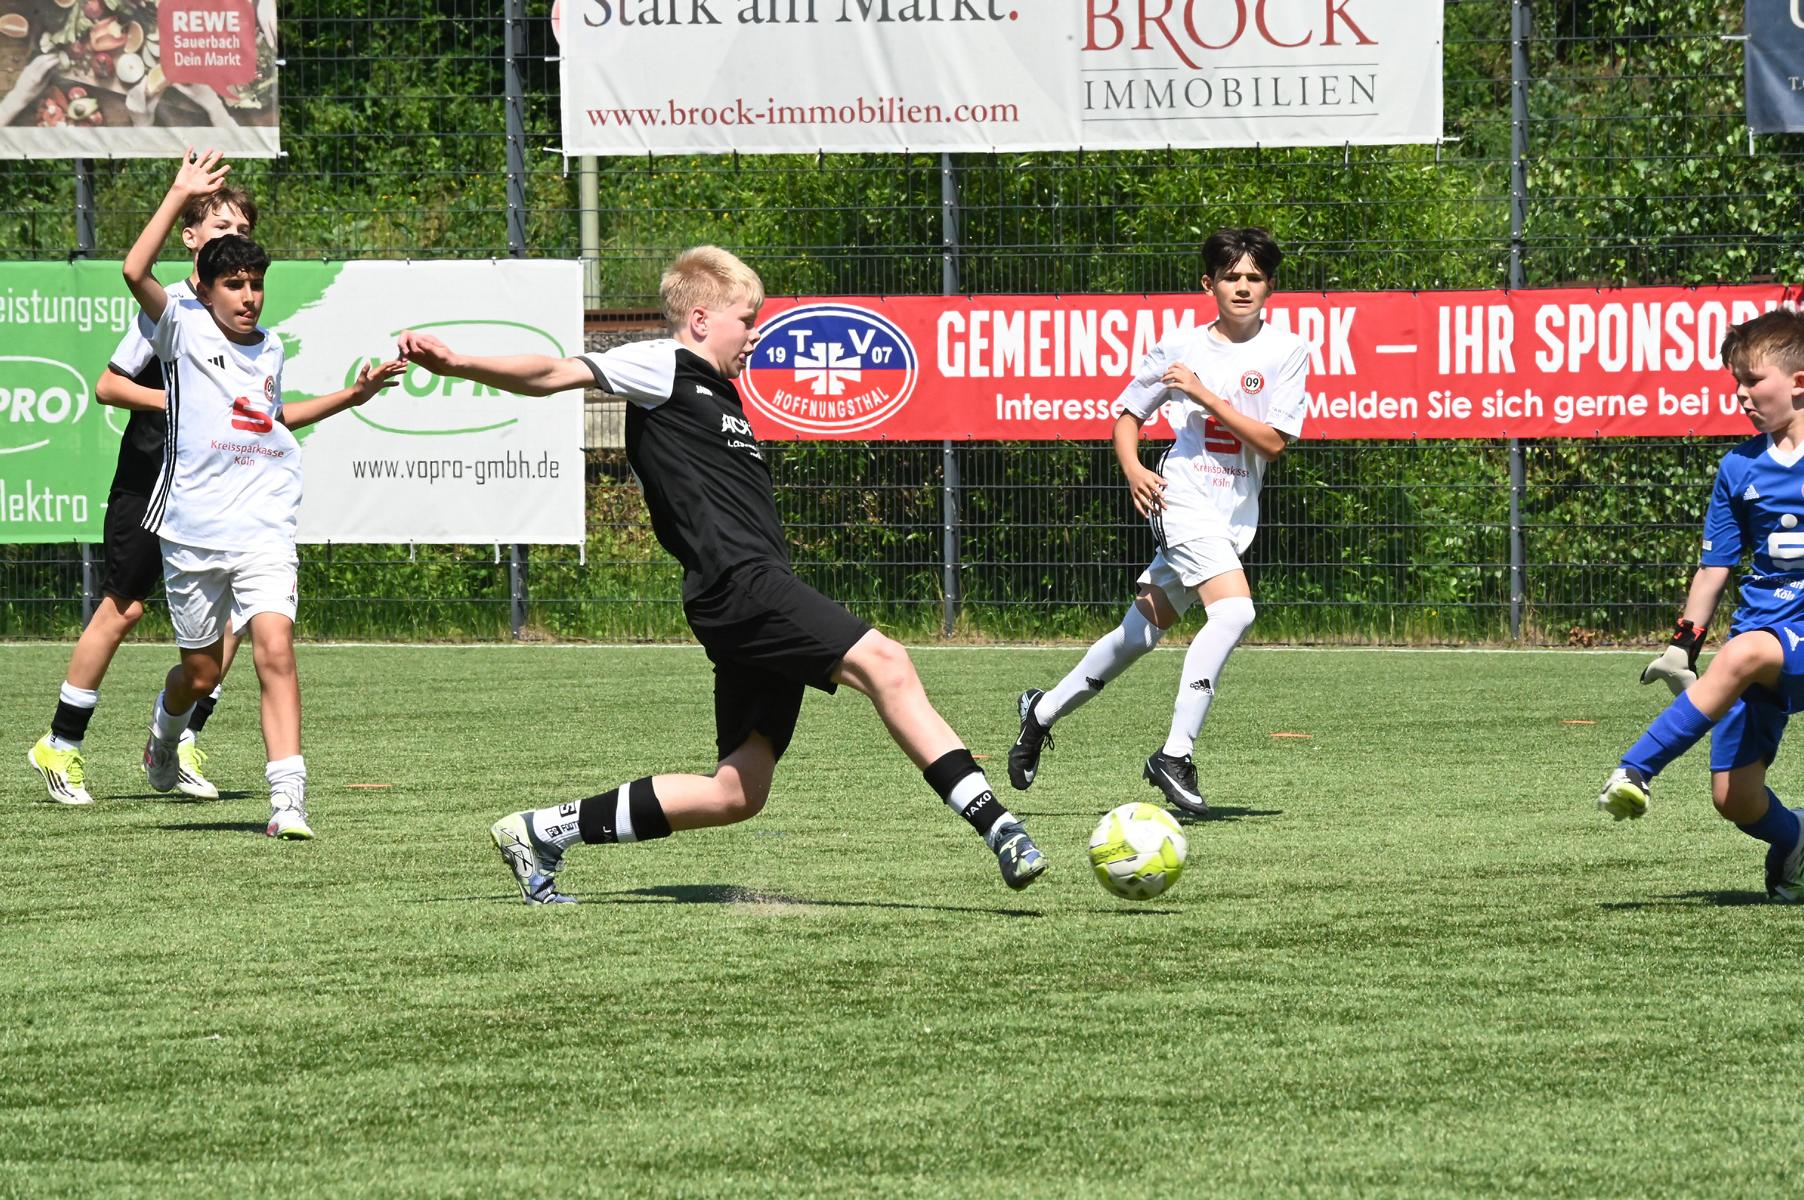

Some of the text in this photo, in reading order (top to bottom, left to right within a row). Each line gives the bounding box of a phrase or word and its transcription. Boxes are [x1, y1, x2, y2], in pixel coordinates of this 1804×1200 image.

[172, 11, 241, 32] REWE
[584, 0, 1018, 27] Stark am Markt.
[174, 35, 241, 49] Sauerbach
[1081, 0, 1379, 70] BROCK
[174, 51, 242, 66] Dein Markt
[1083, 74, 1378, 110] IMMOBILIEN
[587, 97, 1019, 127] www.brock-immobilien.com
[1438, 305, 1516, 375] IHR
[766, 346, 893, 364] 19 07
[1245, 376, 1259, 388] 09
[772, 387, 890, 418] HOFFNUNGSTHAL
[1303, 390, 1418, 420] Melden
[1428, 389, 1472, 419] Sie
[1481, 388, 1544, 418] sich
[1553, 396, 1649, 424] gerne
[1658, 386, 1710, 416] bei
[210, 440, 284, 458] Kreissparkasse
[234, 456, 255, 467] Köln
[353, 449, 560, 485] www.vopro-gmbh.de
[1212, 477, 1231, 489] Köln
[1773, 587, 1796, 601] Köln
